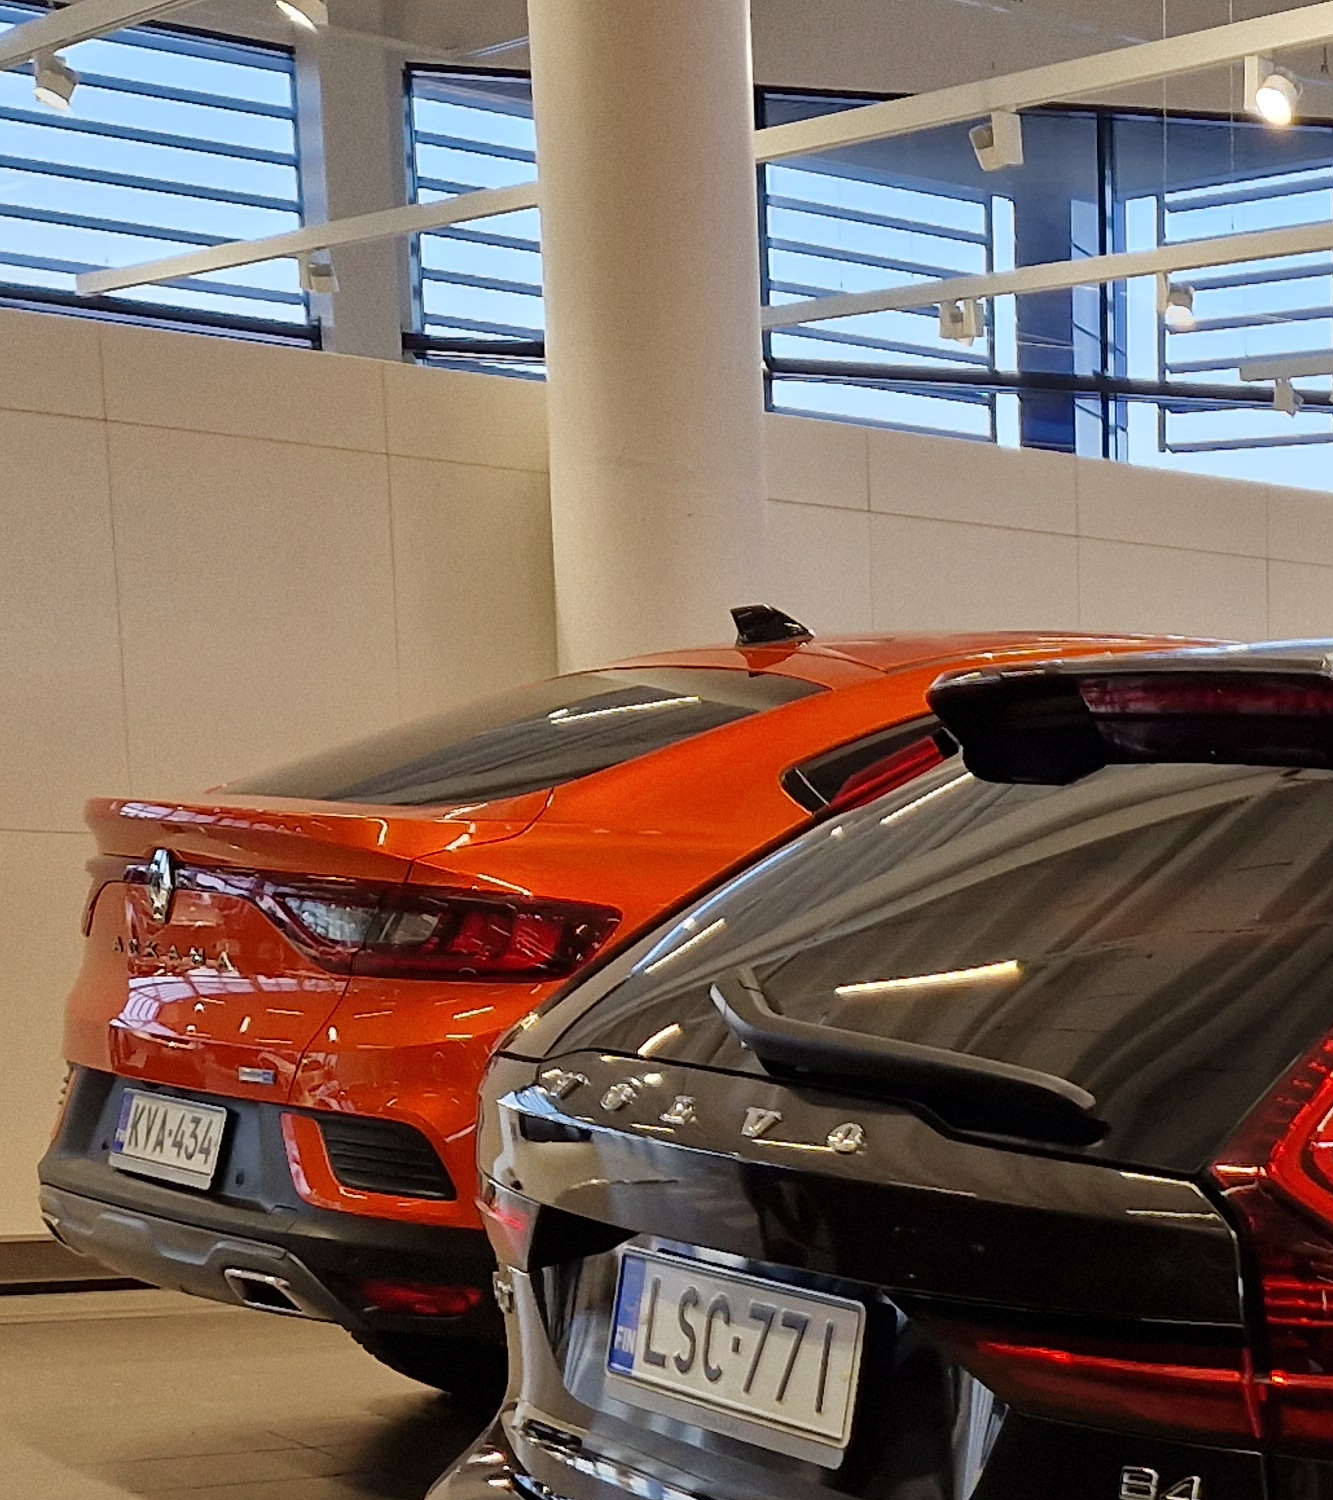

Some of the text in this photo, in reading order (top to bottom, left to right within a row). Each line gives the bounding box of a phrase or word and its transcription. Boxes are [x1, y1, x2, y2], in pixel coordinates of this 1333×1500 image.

[114, 934, 238, 973] ARKANA
[541, 1067, 868, 1155] VOLVO
[615, 1328, 637, 1354] FIN
[642, 1275, 835, 1415] LSC-771
